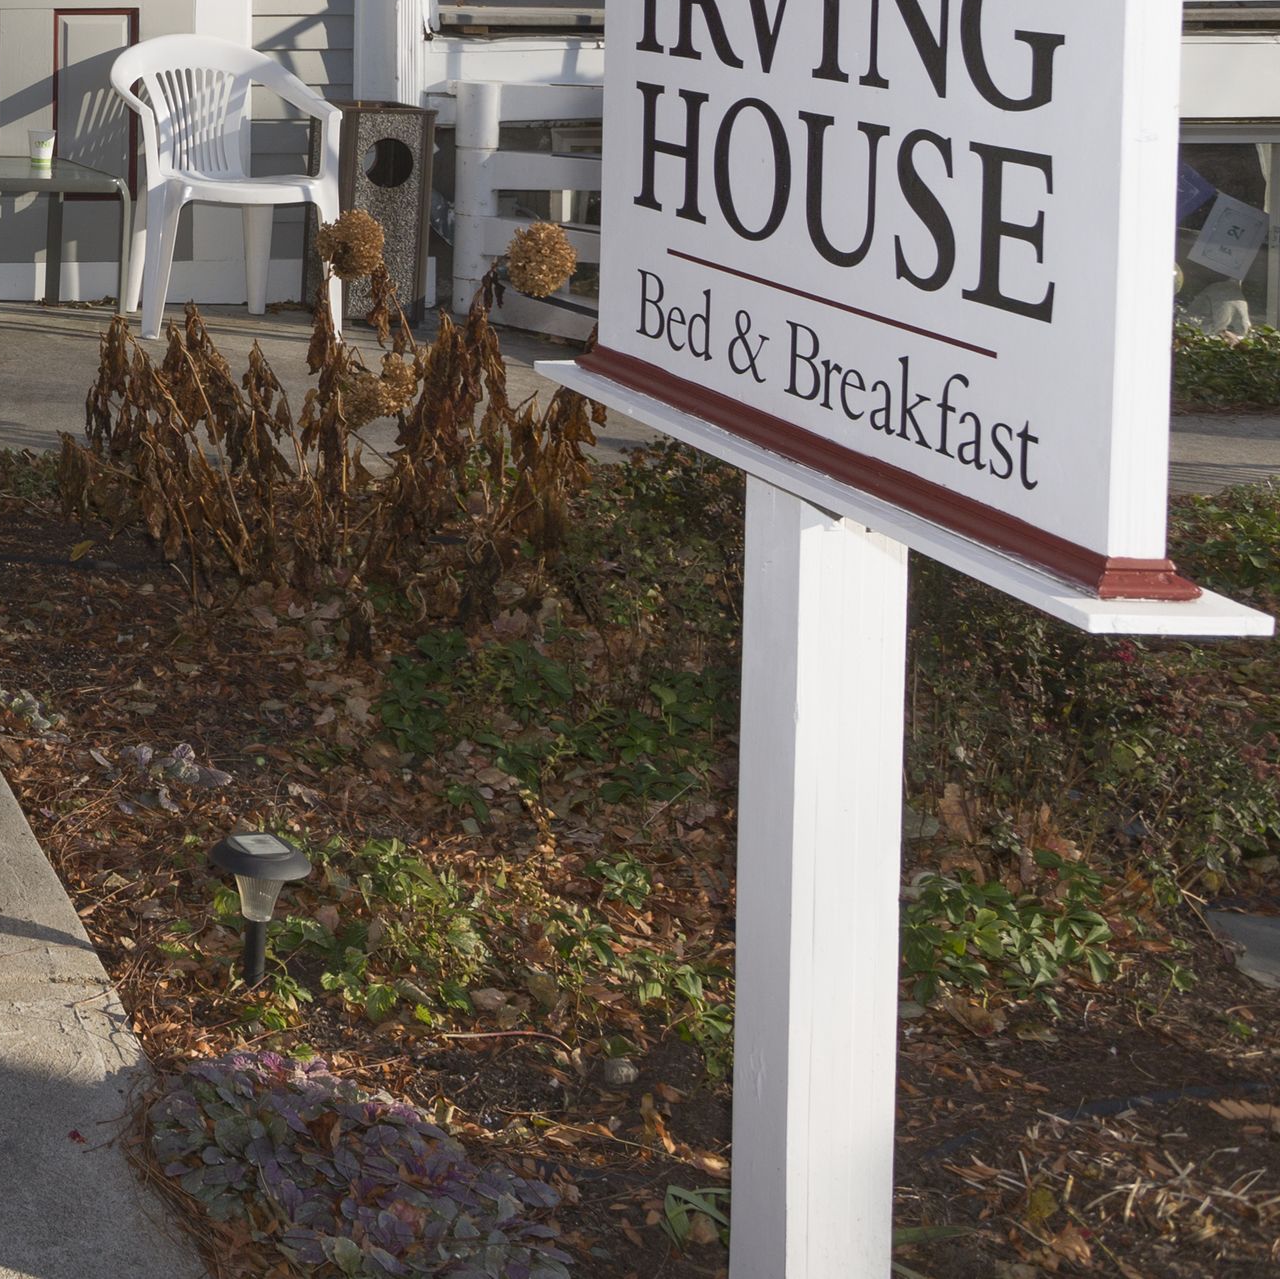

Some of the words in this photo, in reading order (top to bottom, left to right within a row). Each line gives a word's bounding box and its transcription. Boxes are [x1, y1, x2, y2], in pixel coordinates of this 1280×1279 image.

[633, 80, 1056, 324] HOUSE
[636, 268, 713, 362] Bed
[727, 309, 770, 384] &
[784, 319, 1040, 491] Breakfast
